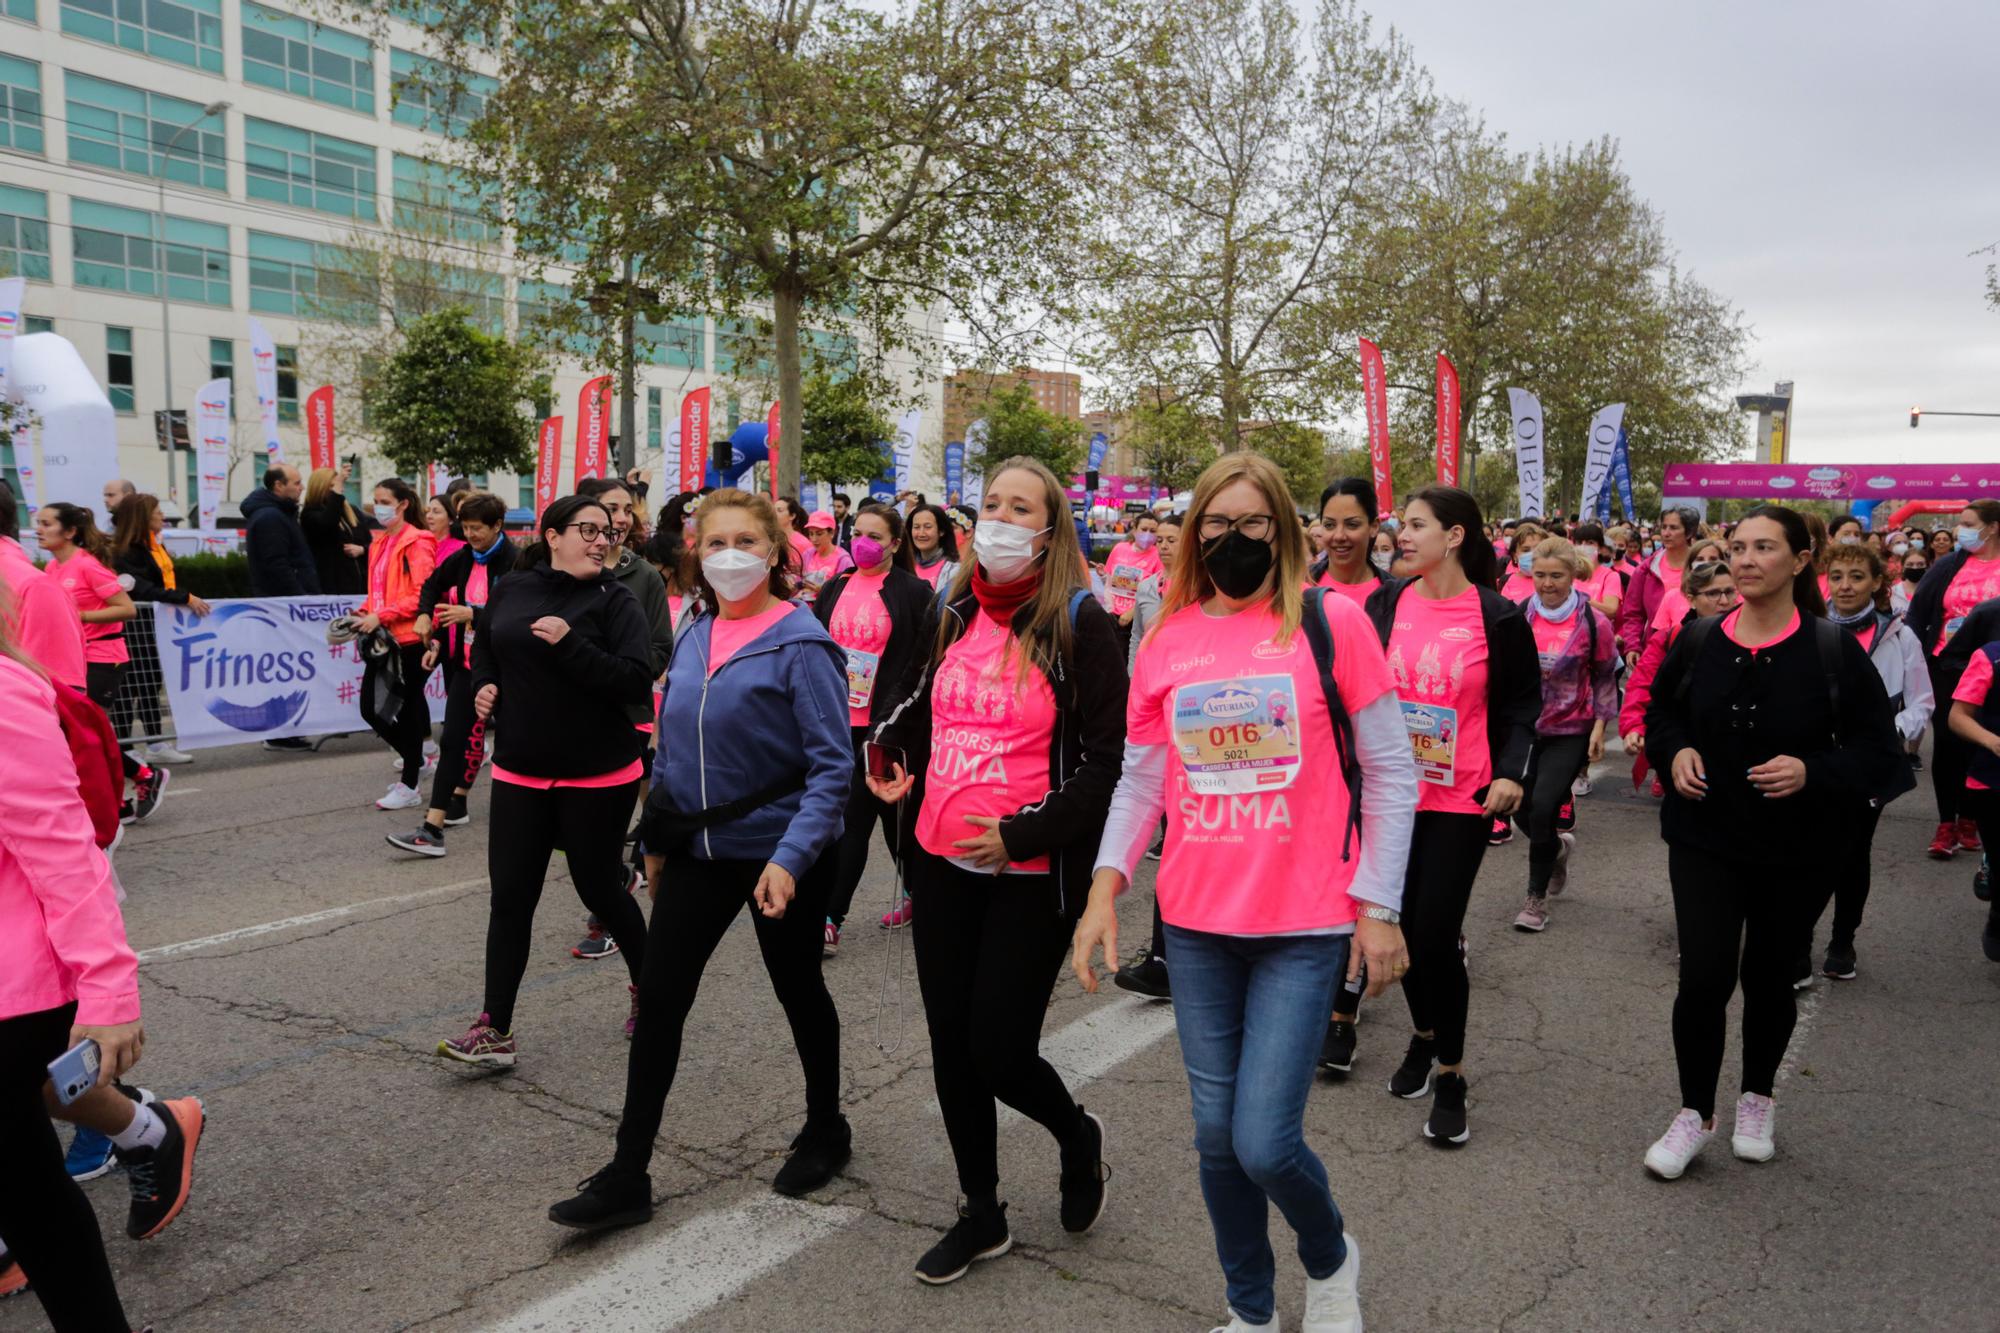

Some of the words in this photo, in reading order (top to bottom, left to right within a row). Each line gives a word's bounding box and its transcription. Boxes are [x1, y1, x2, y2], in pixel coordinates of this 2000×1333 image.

[315, 397, 330, 468] Santander
[585, 389, 599, 467] Santander
[689, 400, 702, 472] Santander
[541, 425, 555, 484] Santander
[171, 632, 316, 693] Fitness
[1207, 700, 1256, 714] ASTURIANA
[1208, 722, 1259, 747] 016
[1224, 749, 1249, 760] 5021
[1201, 763, 1231, 772] CARRERA
[1241, 761, 1251, 769] LA
[1251, 759, 1274, 767] MUJER
[1178, 794, 1292, 830] SUMA
